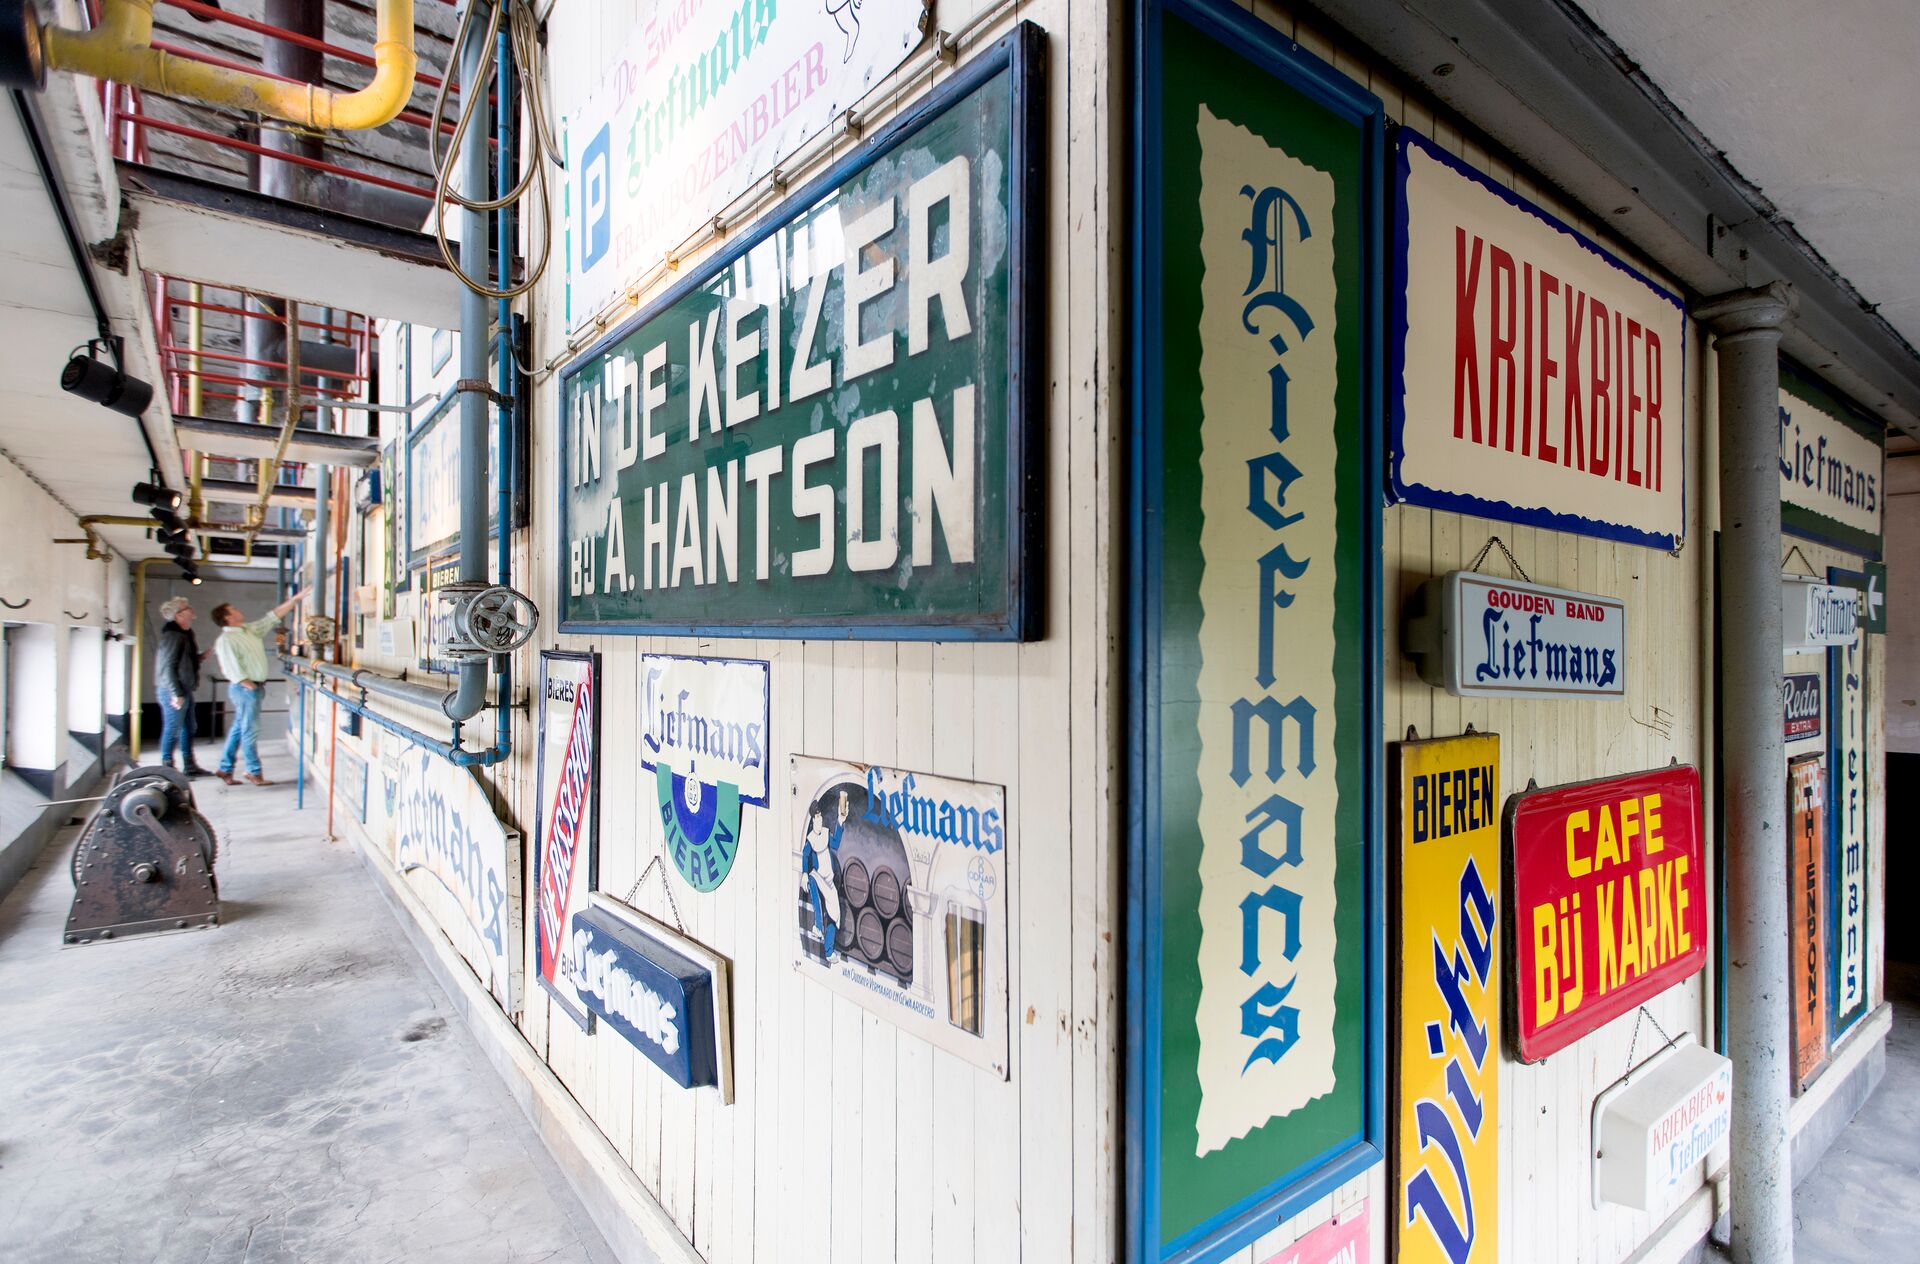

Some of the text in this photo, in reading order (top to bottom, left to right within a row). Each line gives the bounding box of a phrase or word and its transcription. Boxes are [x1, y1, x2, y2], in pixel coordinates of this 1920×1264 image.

[614, 42, 828, 269] FRAMBOZENBIER
[574, 154, 972, 488] IN DE KEIZER
[1452, 225, 1663, 493] KRIEKBIER
[603, 495, 636, 594] A.
[643, 383, 976, 591] HANTSON
[1779, 405, 1876, 515] Liefmans
[1227, 183, 1317, 1080] Liefmans
[1475, 607, 1616, 688] Liefmans
[1487, 588, 1605, 623] GOUDEN BAND
[1808, 585, 1858, 641] Liefmans
[643, 666, 762, 770] Liefmans
[1783, 678, 1820, 720] Reda
[1791, 719, 1812, 734] EXTRA
[660, 800, 734, 885] BIEREN
[863, 765, 1003, 855] Liefmans
[1411, 764, 1495, 845] BIEREN
[1564, 792, 1665, 880] CAFE
[1597, 854, 1692, 997] KARKE
[1803, 786, 1817, 1026] THIENPONT
[573, 927, 680, 1056] Liefmans
[1653, 1081, 1714, 1157] KRIEKBIER
[1668, 1109, 1728, 1185] Liefmans
